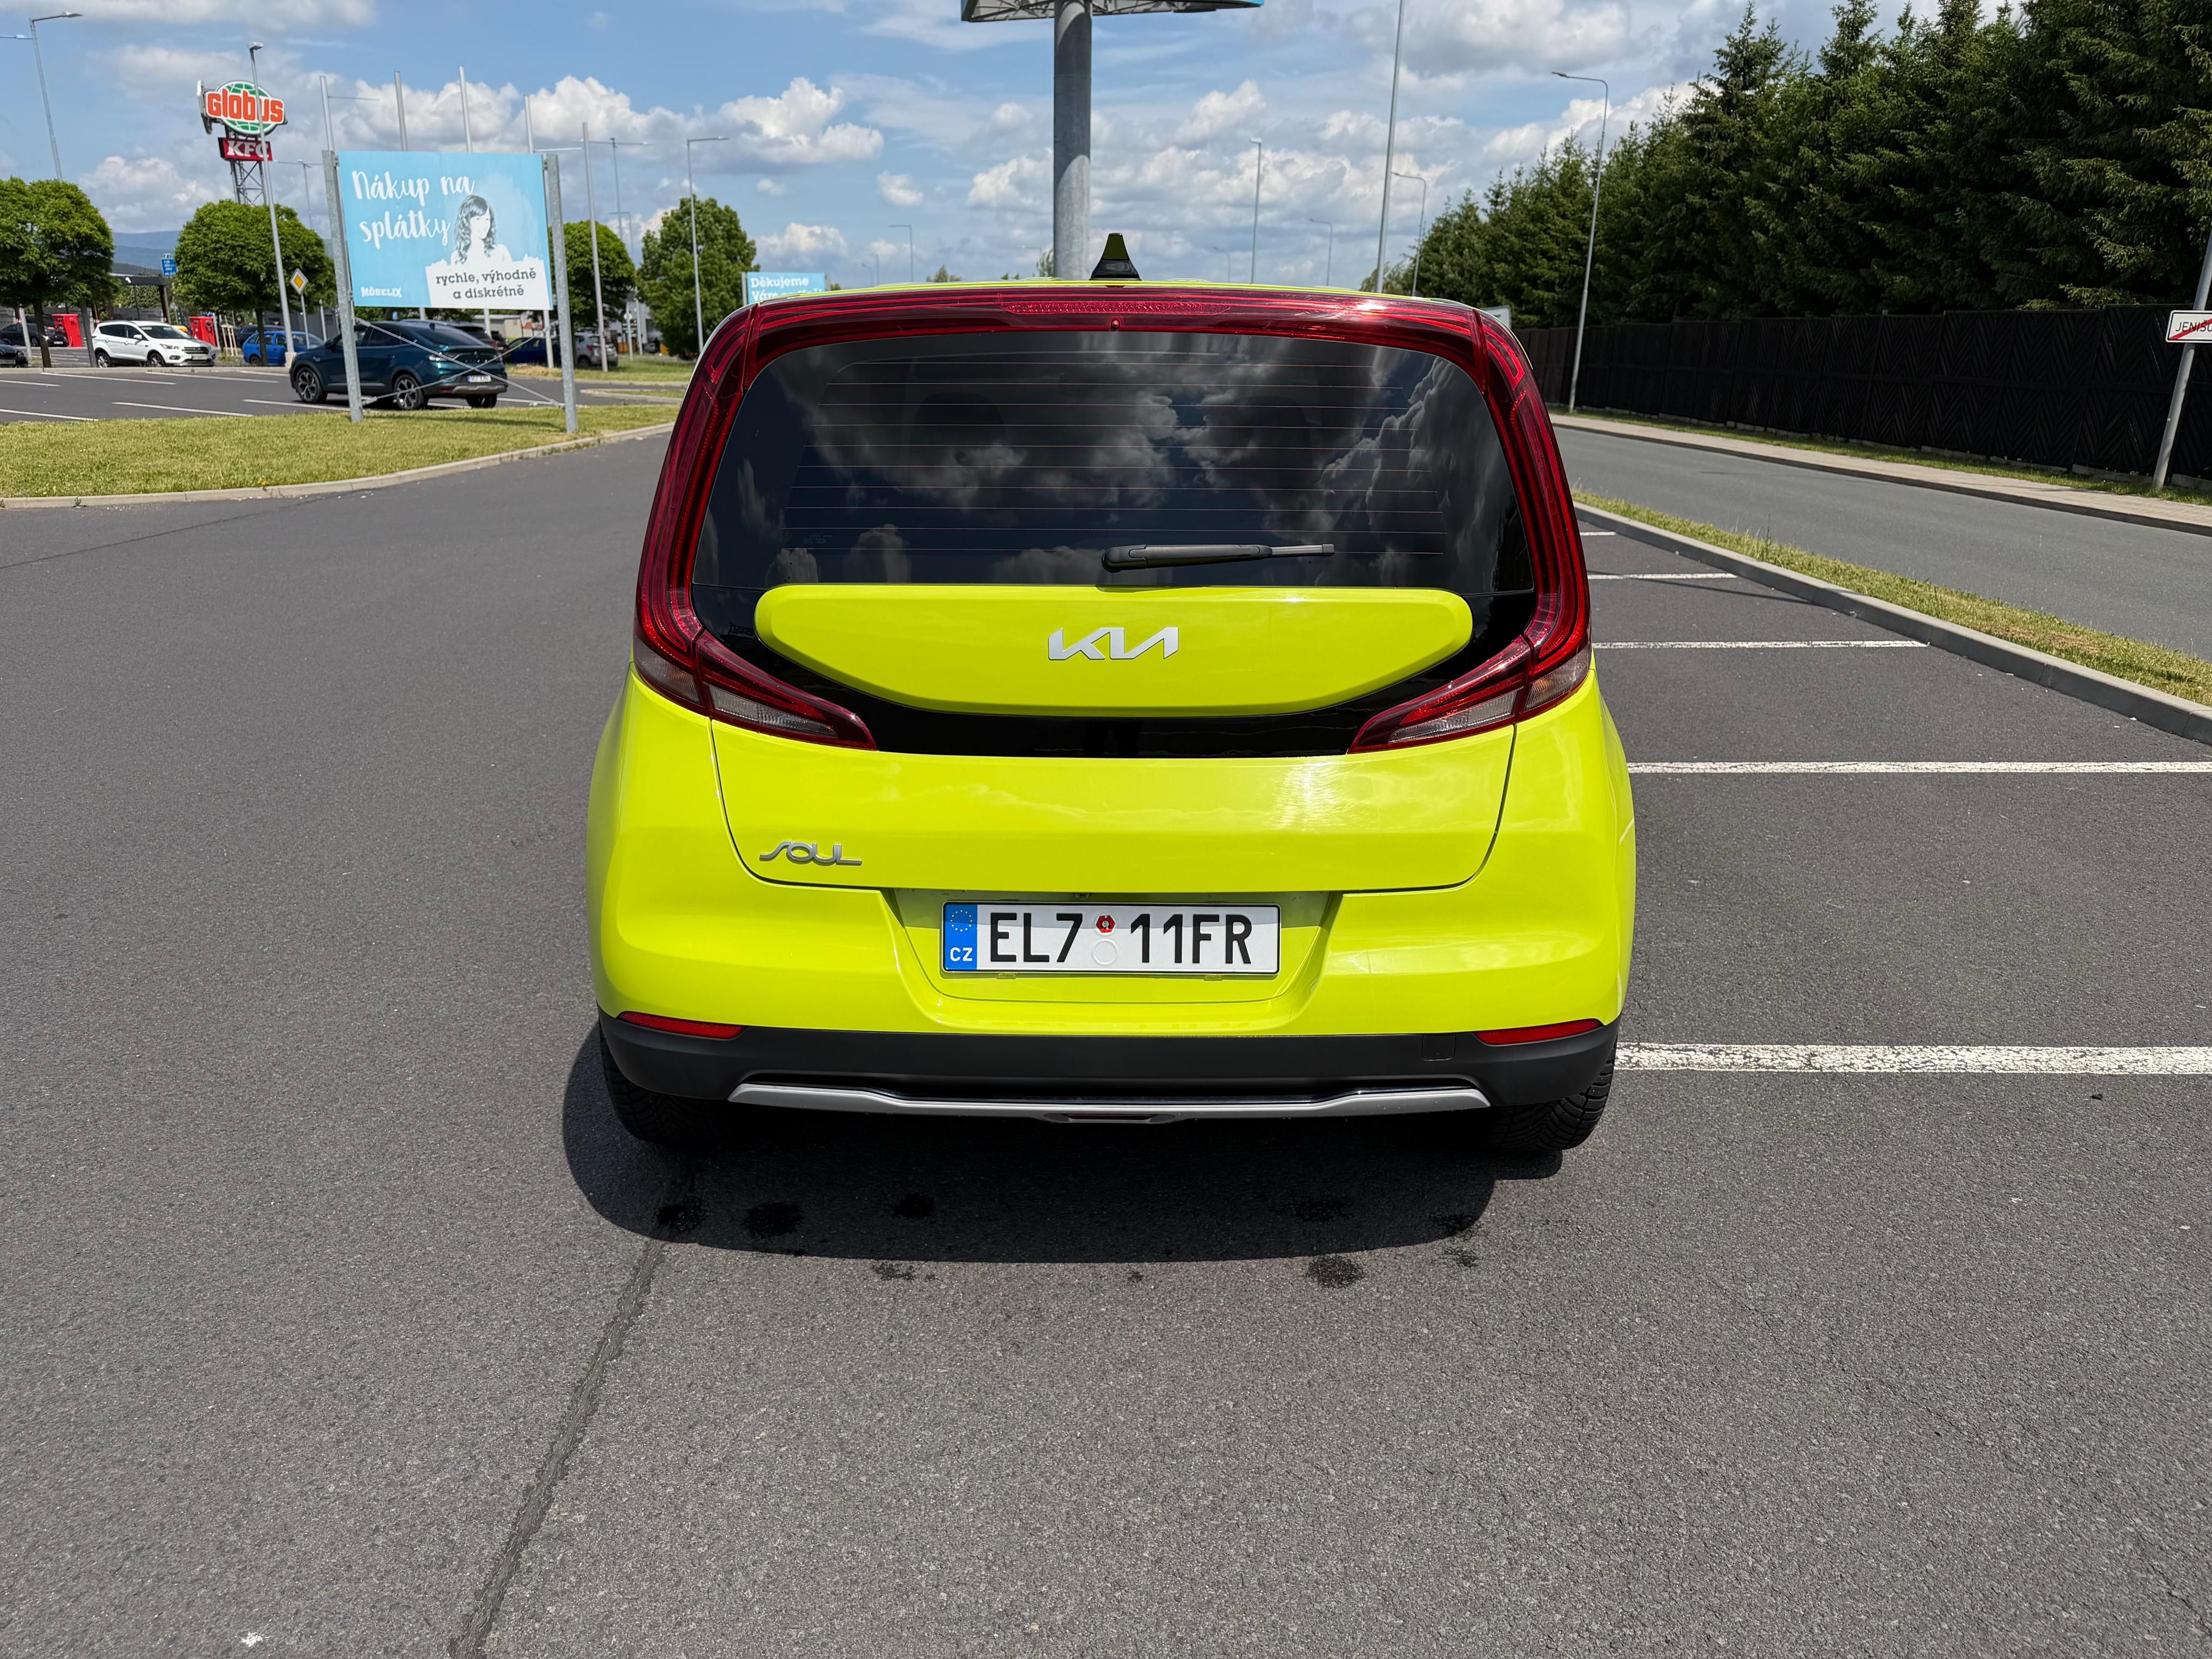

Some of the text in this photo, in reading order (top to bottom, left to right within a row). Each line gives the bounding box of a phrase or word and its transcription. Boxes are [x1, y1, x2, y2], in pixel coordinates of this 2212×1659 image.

[207, 88, 284, 122] Globus
[227, 140, 269, 158] KFC
[352, 171, 475, 206] Nákup na
[359, 210, 451, 249] splátky
[435, 267, 537, 287] rychle, výhodně
[751, 276, 810, 289] Děkujeme
[361, 286, 402, 298] MÖBELIX
[453, 285, 524, 299] a diskrétně
[1048, 627, 1179, 660] KIA
[990, 912, 1252, 965] EL7 11FR
[949, 947, 973, 962] CZ
